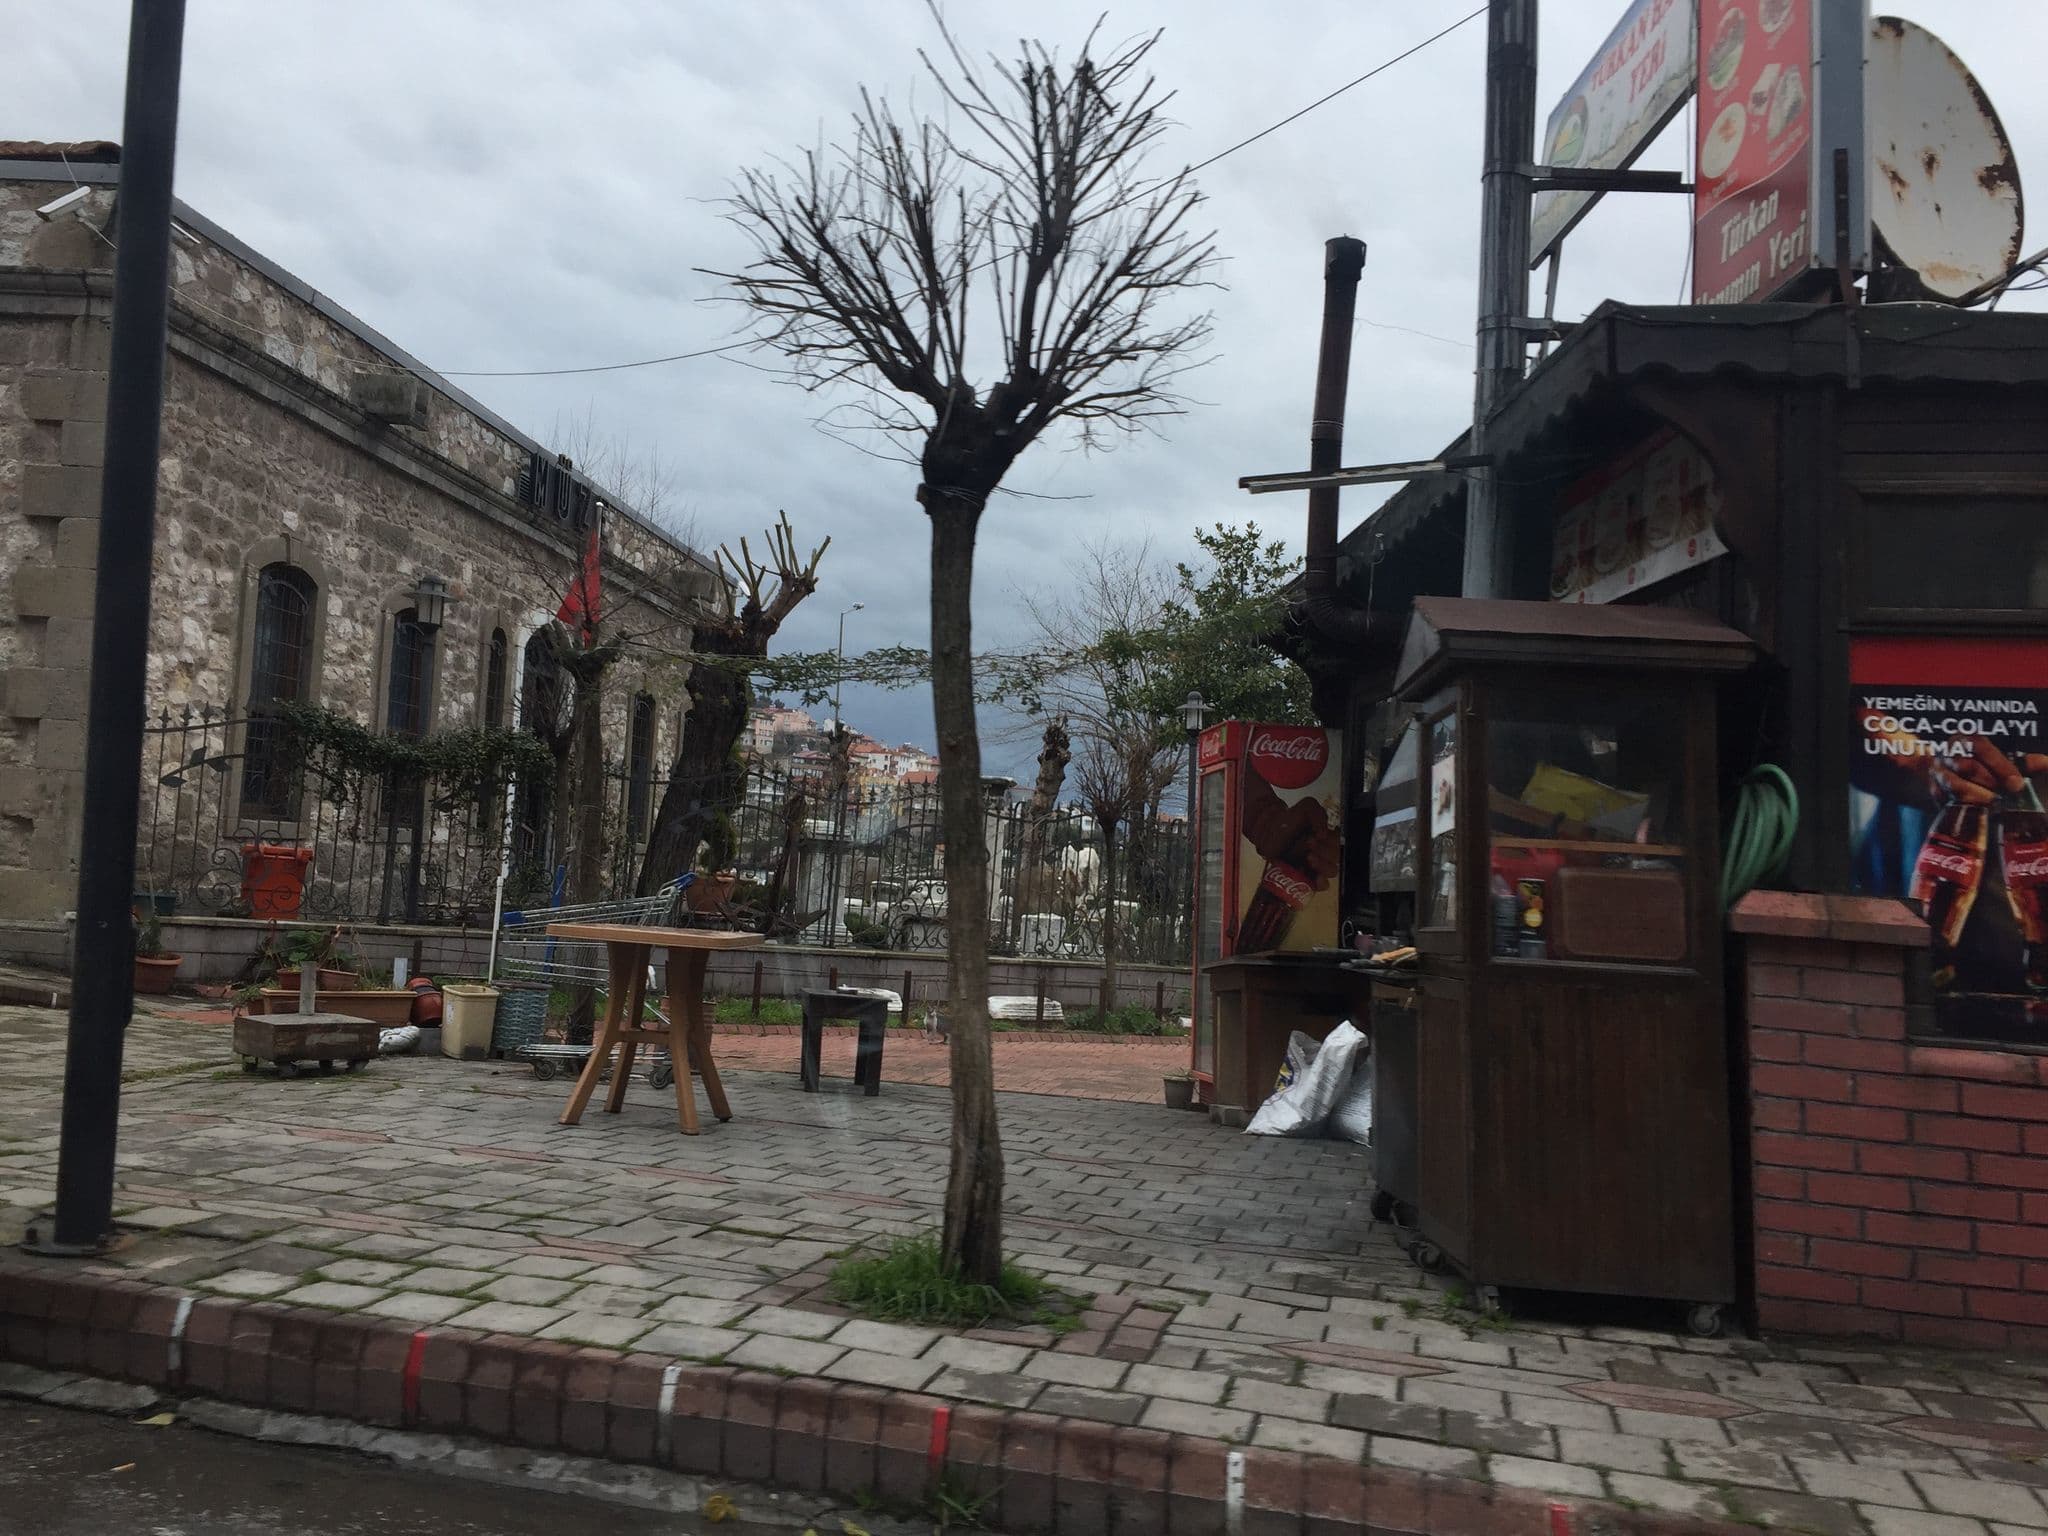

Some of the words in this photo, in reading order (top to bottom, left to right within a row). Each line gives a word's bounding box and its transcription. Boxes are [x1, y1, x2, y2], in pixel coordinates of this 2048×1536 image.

[1720, 189, 1778, 264] Türkan
[1769, 209, 1806, 278] Yeri
[1863, 694, 1946, 711] YEMEĞİN
[1951, 699, 2039, 714] YANINDA
[1863, 715, 2038, 737] COCA-COLA'YI
[1253, 733, 1324, 760] Coca-Cola
[1863, 738, 1974, 758] UNUTMA!
